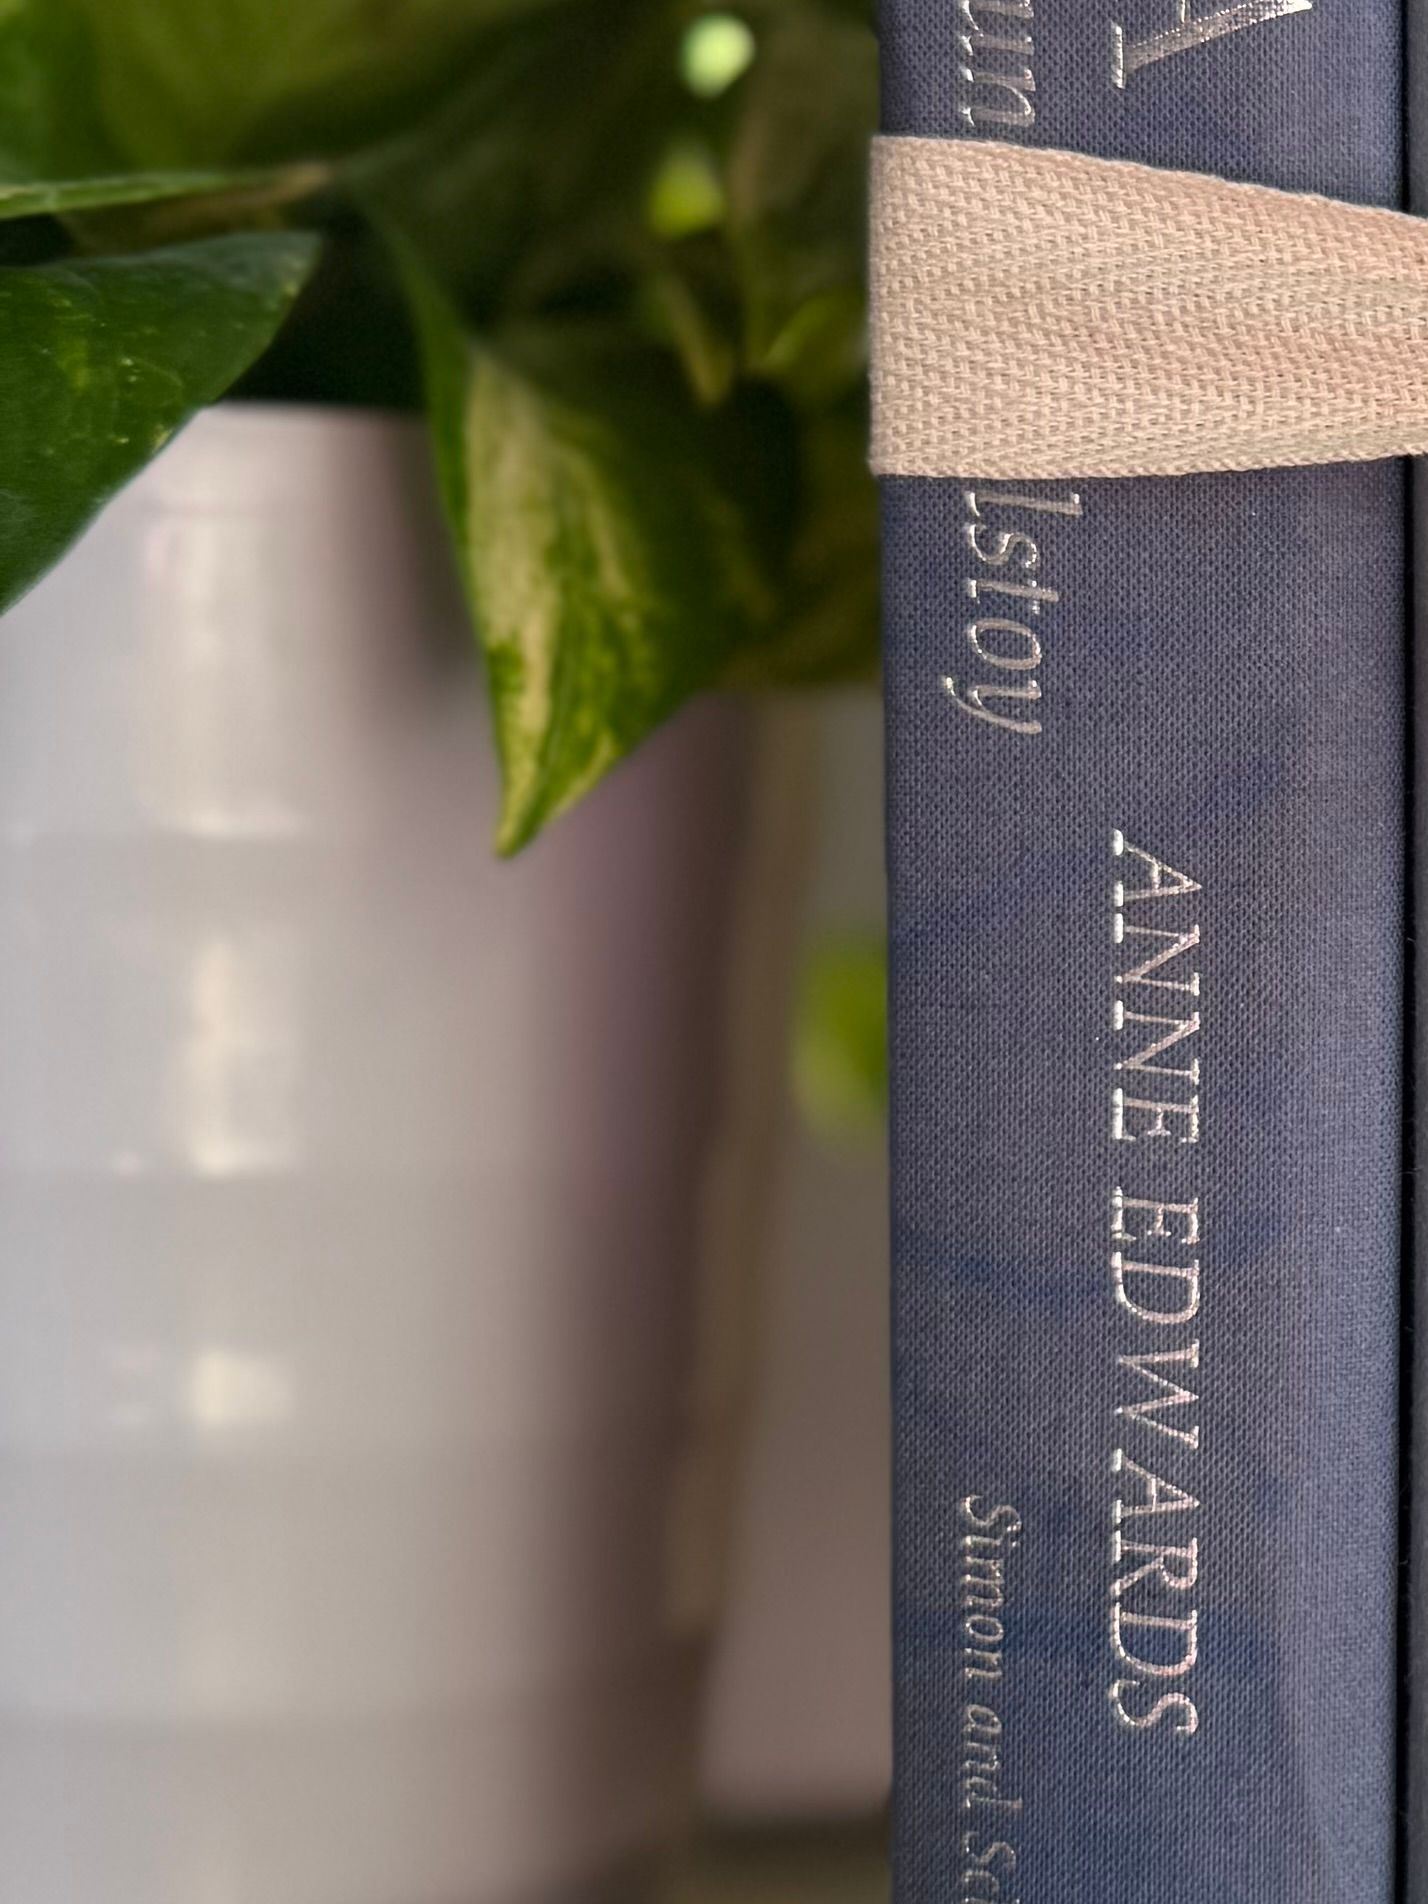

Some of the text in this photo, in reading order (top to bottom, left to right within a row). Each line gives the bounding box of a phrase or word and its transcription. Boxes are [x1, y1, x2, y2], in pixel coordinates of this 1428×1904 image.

[942, 490, 1083, 736] lstoy
[1108, 827, 1203, 1737] ANNE EDWARDS
[960, 1495, 1023, 1680] Simon
[962, 1703, 1023, 1810] and
